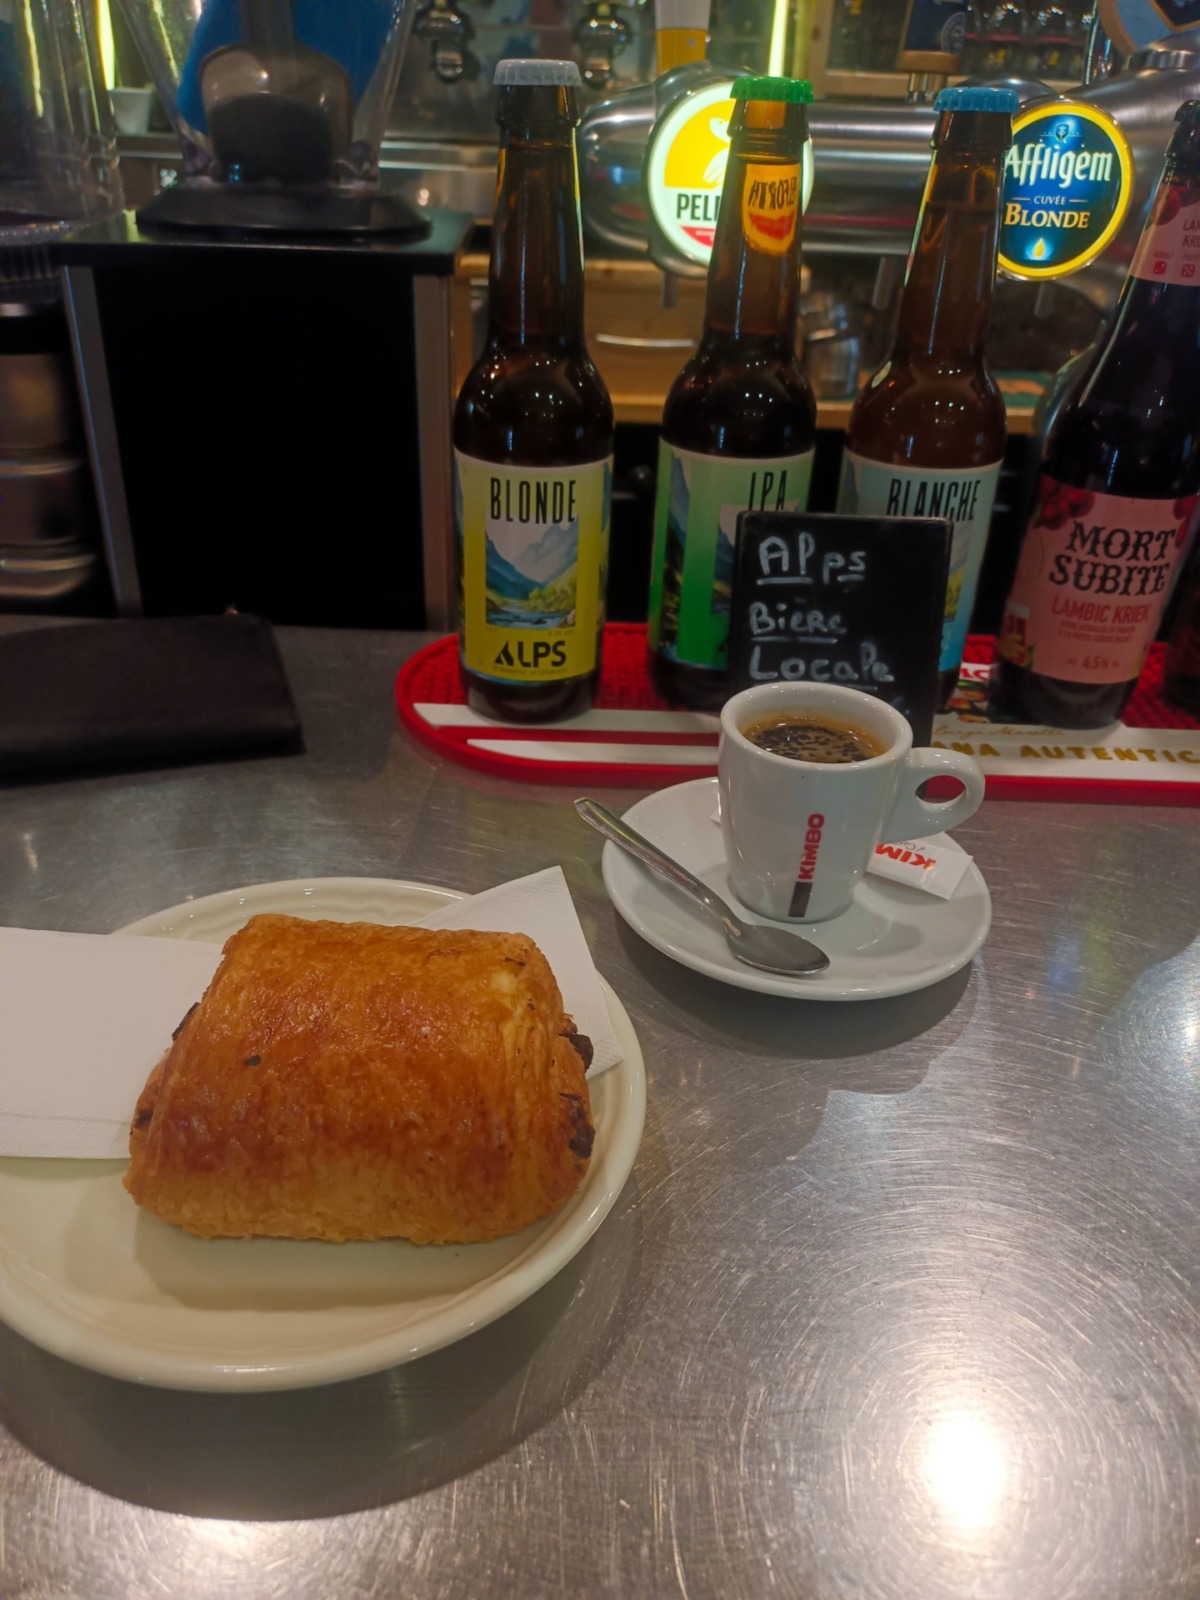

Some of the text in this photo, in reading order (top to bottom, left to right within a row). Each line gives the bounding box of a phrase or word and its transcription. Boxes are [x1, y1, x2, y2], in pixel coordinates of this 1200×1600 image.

[1005, 143, 1113, 189] Affligem
[1004, 202, 1090, 229] BLONDE
[1033, 195, 1067, 206] CUVÉE
[490, 477, 576, 524] BLONDE
[748, 470, 787, 511] IPA
[887, 478, 981, 522] BLANCHE
[1065, 520, 1176, 562] MORT
[1050, 554, 1170, 596] SUBITE
[1051, 596, 1152, 624] LAMBIC KRIEK
[494, 640, 567, 668] ALPS
[797, 813, 825, 880] KIMBO
